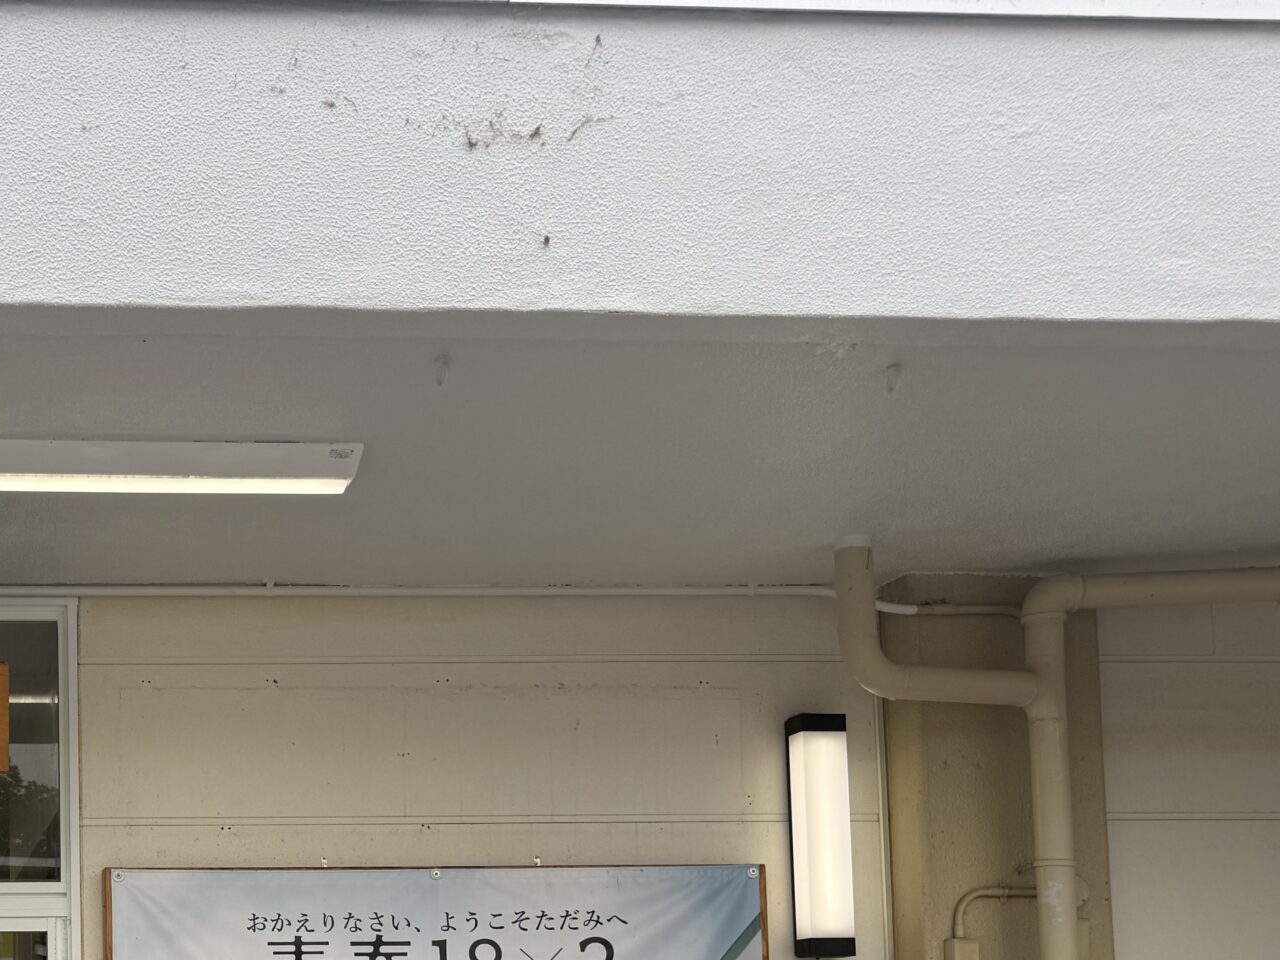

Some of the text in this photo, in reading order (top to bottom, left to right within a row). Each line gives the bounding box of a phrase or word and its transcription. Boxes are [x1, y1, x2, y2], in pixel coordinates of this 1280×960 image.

[246, 910, 629, 933] おかえりなさい、ようこそただみへ
